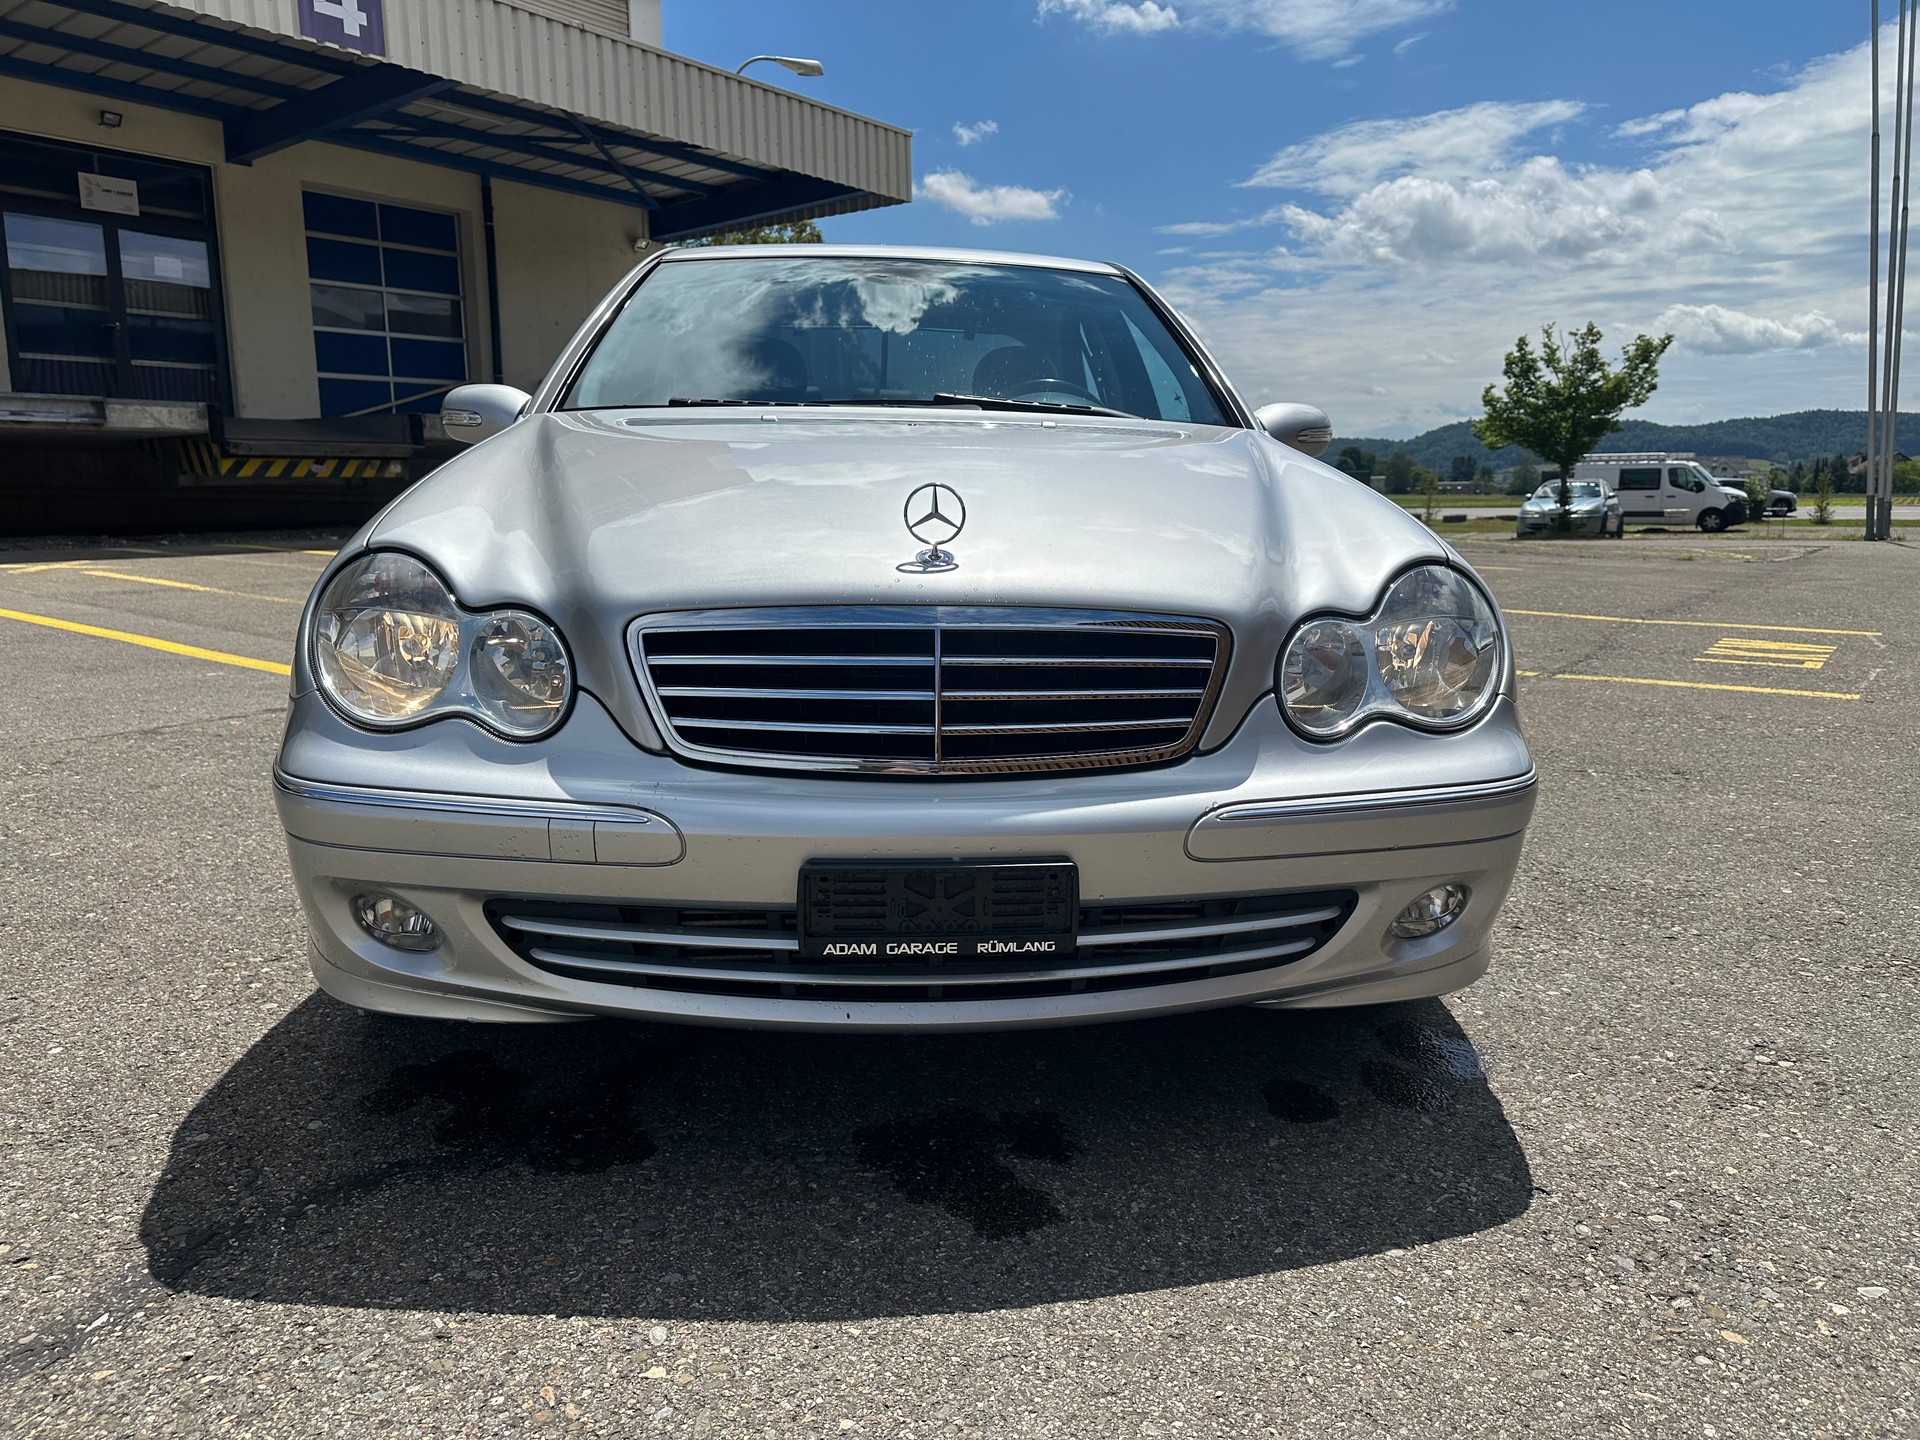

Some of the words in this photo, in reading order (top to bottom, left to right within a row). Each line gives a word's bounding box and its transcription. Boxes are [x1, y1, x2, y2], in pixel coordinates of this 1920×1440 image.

[822, 943, 877, 955] ADAM
[886, 942, 958, 954] GARAGE
[977, 940, 1056, 954] RÜMLANG
